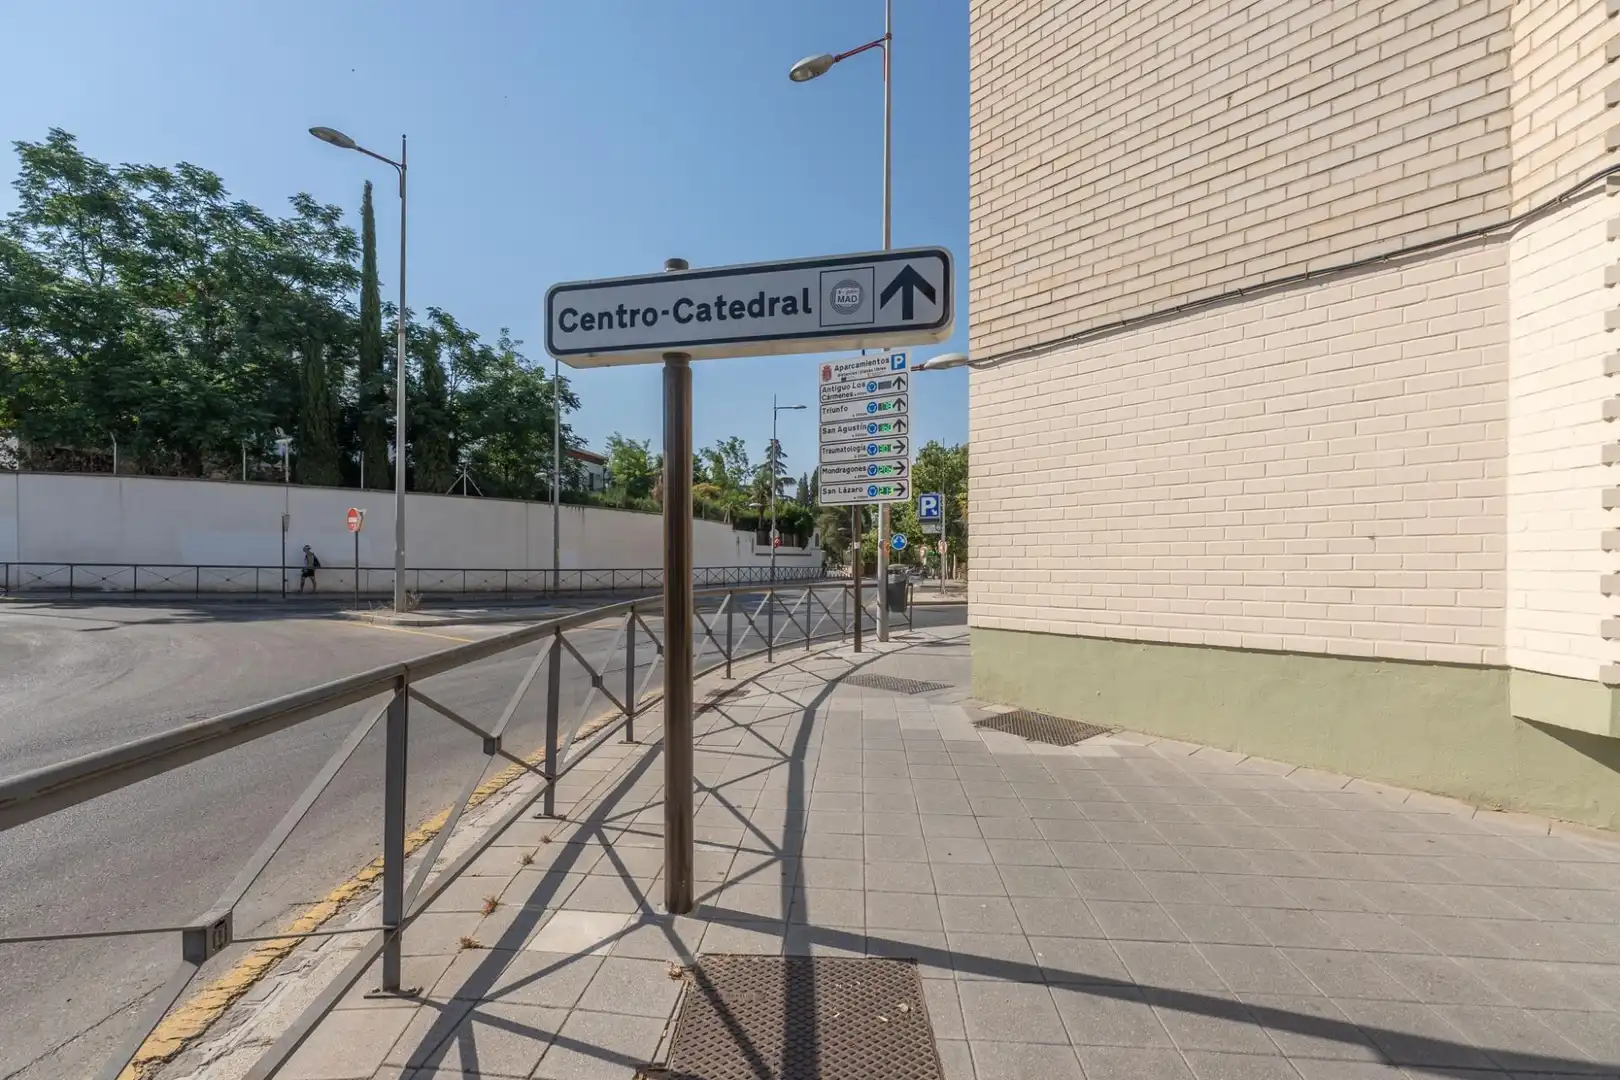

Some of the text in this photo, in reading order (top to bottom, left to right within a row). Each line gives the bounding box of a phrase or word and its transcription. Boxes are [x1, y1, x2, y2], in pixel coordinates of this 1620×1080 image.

[837, 295, 858, 303] MAD
[558, 287, 812, 333] Centro-Catedral
[834, 357, 890, 373] Aparcamientos
[822, 384, 851, 393] Antiguo
[822, 392, 854, 401] Cármenes
[822, 405, 848, 415] Triunfo
[837, 422, 867, 433] Agustín
[822, 444, 866, 454] Traumatología
[822, 466, 867, 475] Mondragones
[838, 486, 863, 494] Lázaro
